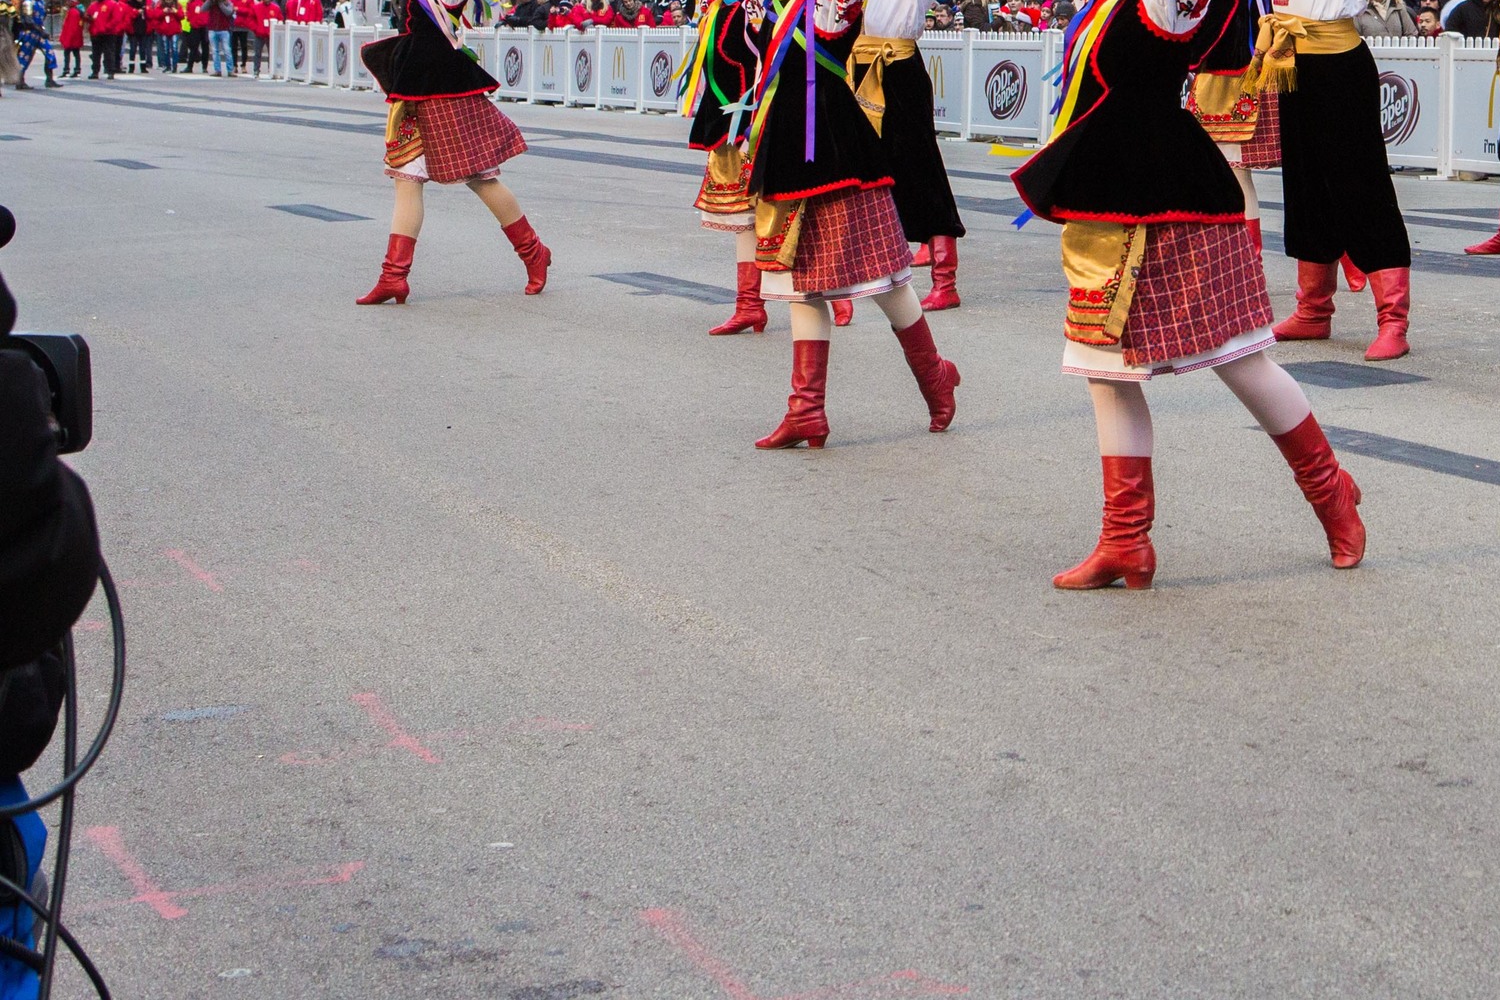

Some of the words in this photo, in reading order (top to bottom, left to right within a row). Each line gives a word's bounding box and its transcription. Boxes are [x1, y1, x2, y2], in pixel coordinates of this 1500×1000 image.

[989, 74, 1020, 112] Pepper
[1000, 69, 1013, 90] Dr
[1380, 95, 1408, 133] pper
[1483, 139, 1496, 154] i'm
